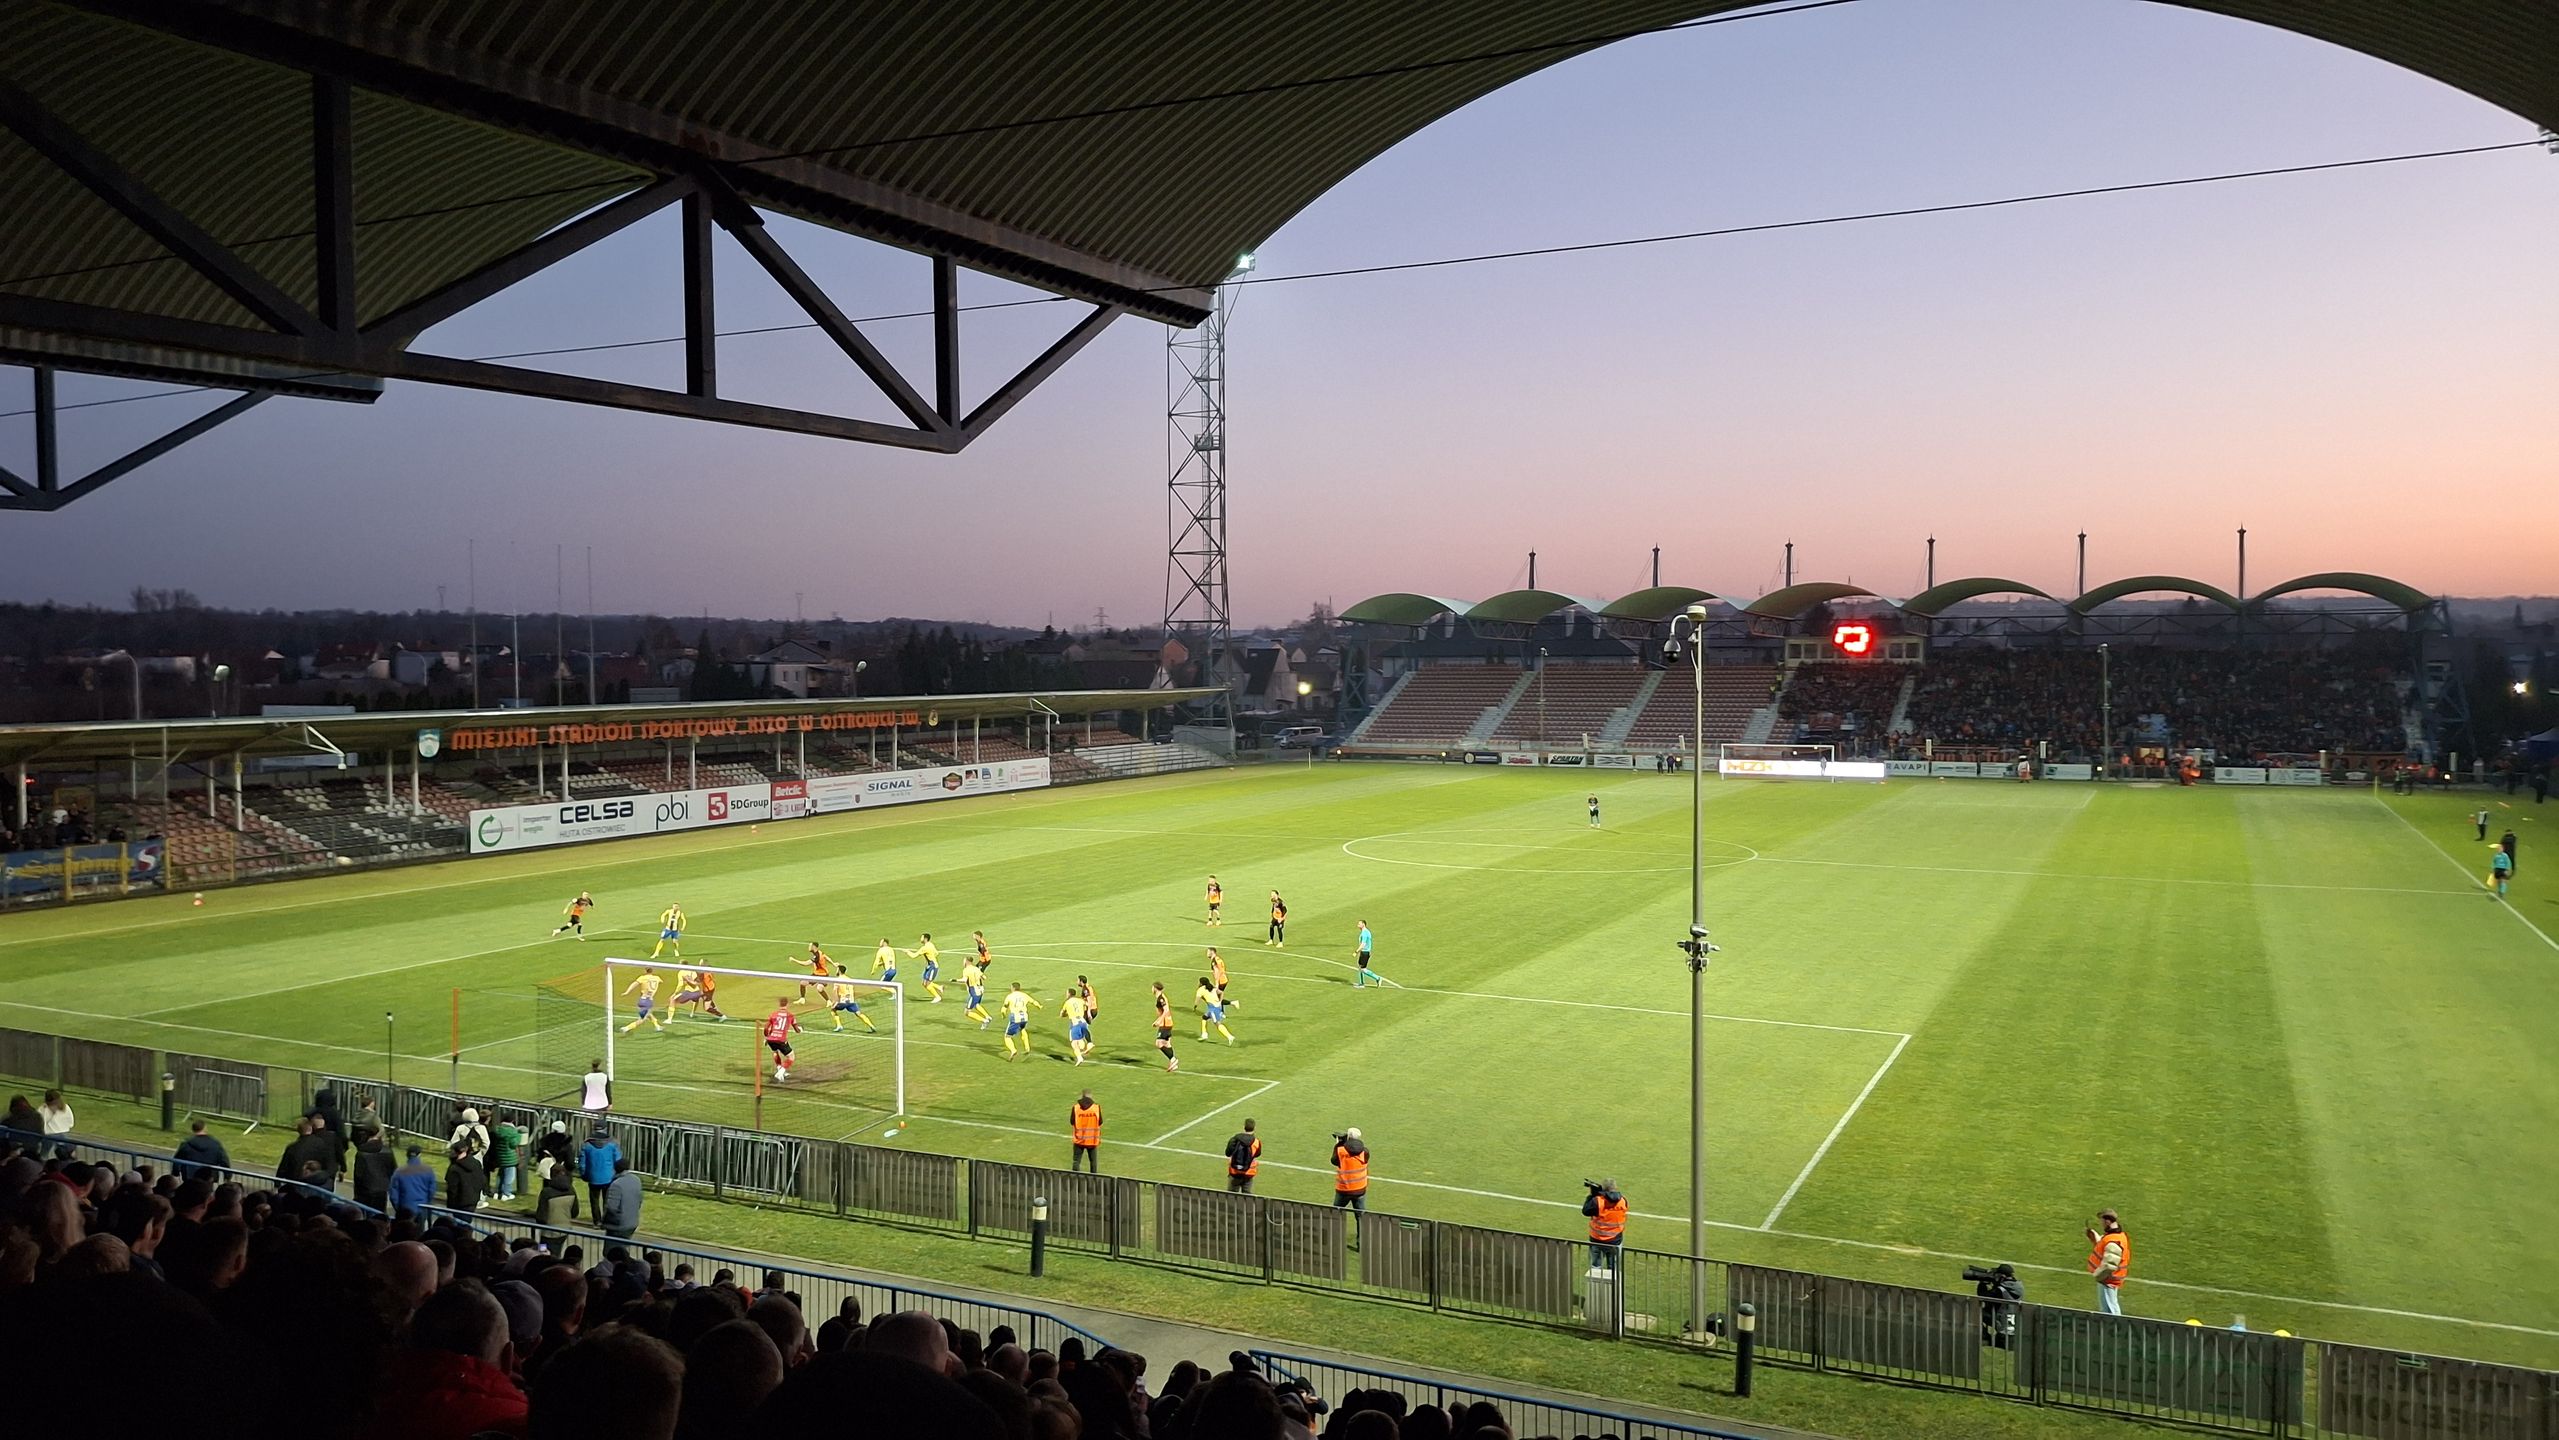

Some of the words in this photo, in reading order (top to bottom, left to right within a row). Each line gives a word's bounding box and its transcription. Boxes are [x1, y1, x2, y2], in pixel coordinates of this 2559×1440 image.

[452, 727, 537, 750] MIEJSKI
[549, 722, 633, 745] STADION
[640, 717, 737, 740] SPORTOWY
[820, 711, 896, 730] OSTROWCU
[867, 779, 913, 792] SIGNAL
[655, 793, 689, 831] pbi
[560, 828, 580, 838] HUTA
[581, 824, 626, 836] OSTROWIEC
[774, 1016, 787, 1030] 31
